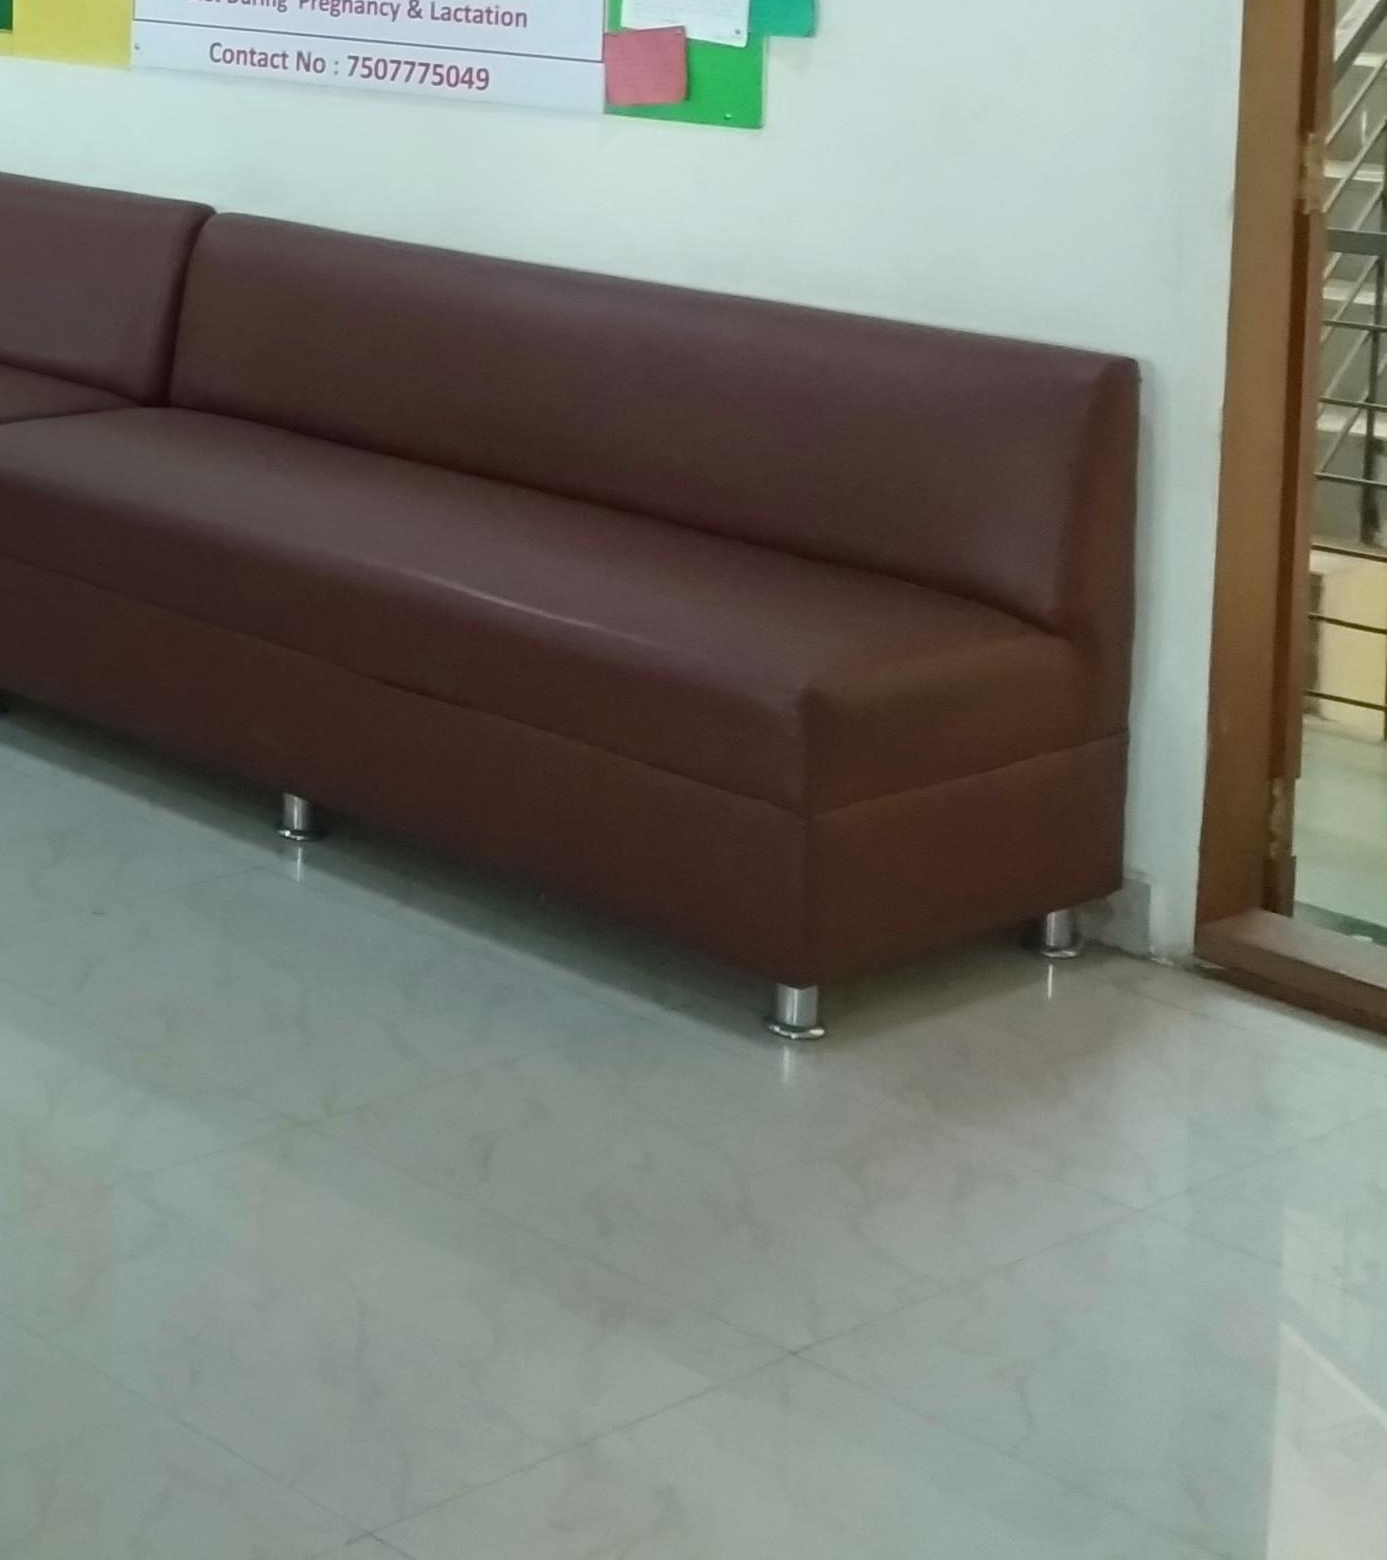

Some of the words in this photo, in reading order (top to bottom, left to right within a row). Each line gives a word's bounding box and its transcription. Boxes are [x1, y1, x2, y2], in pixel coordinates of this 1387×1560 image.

[430, 1, 528, 28] Lactation
[209, 42, 289, 70] Contact
[296, 51, 326, 74] No
[347, 55, 490, 90] 7507775049
